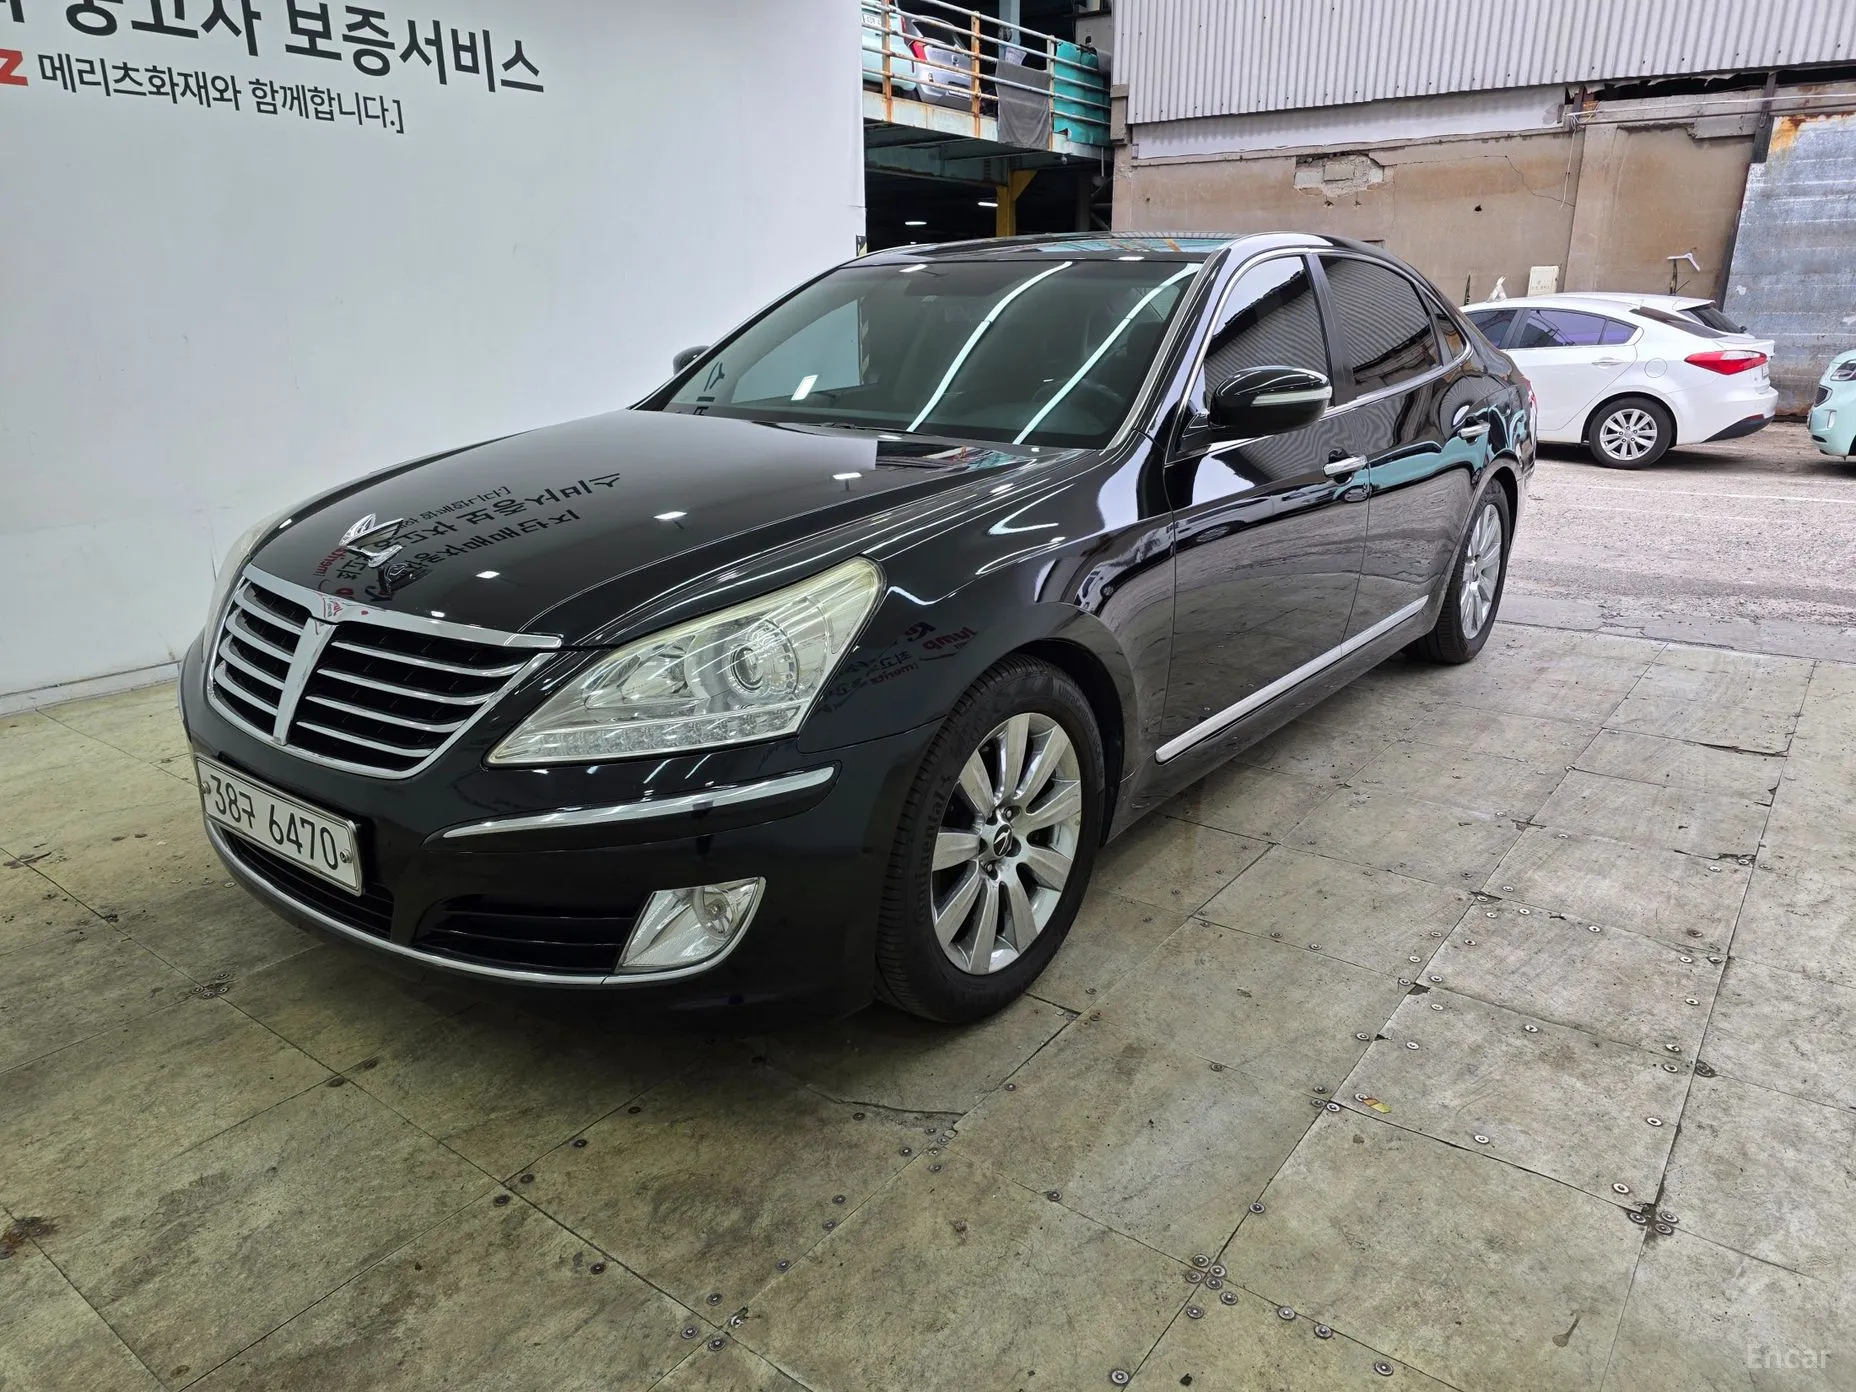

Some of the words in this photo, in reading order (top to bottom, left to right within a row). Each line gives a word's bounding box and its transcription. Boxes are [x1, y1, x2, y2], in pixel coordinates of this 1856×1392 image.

[285, 0, 545, 93] 보증서비스
[37, 52, 242, 111] 메리츠화재와
[248, 78, 405, 135] 함께합니다.]
[210, 774, 256, 829] 38구
[268, 803, 339, 871] 6470
